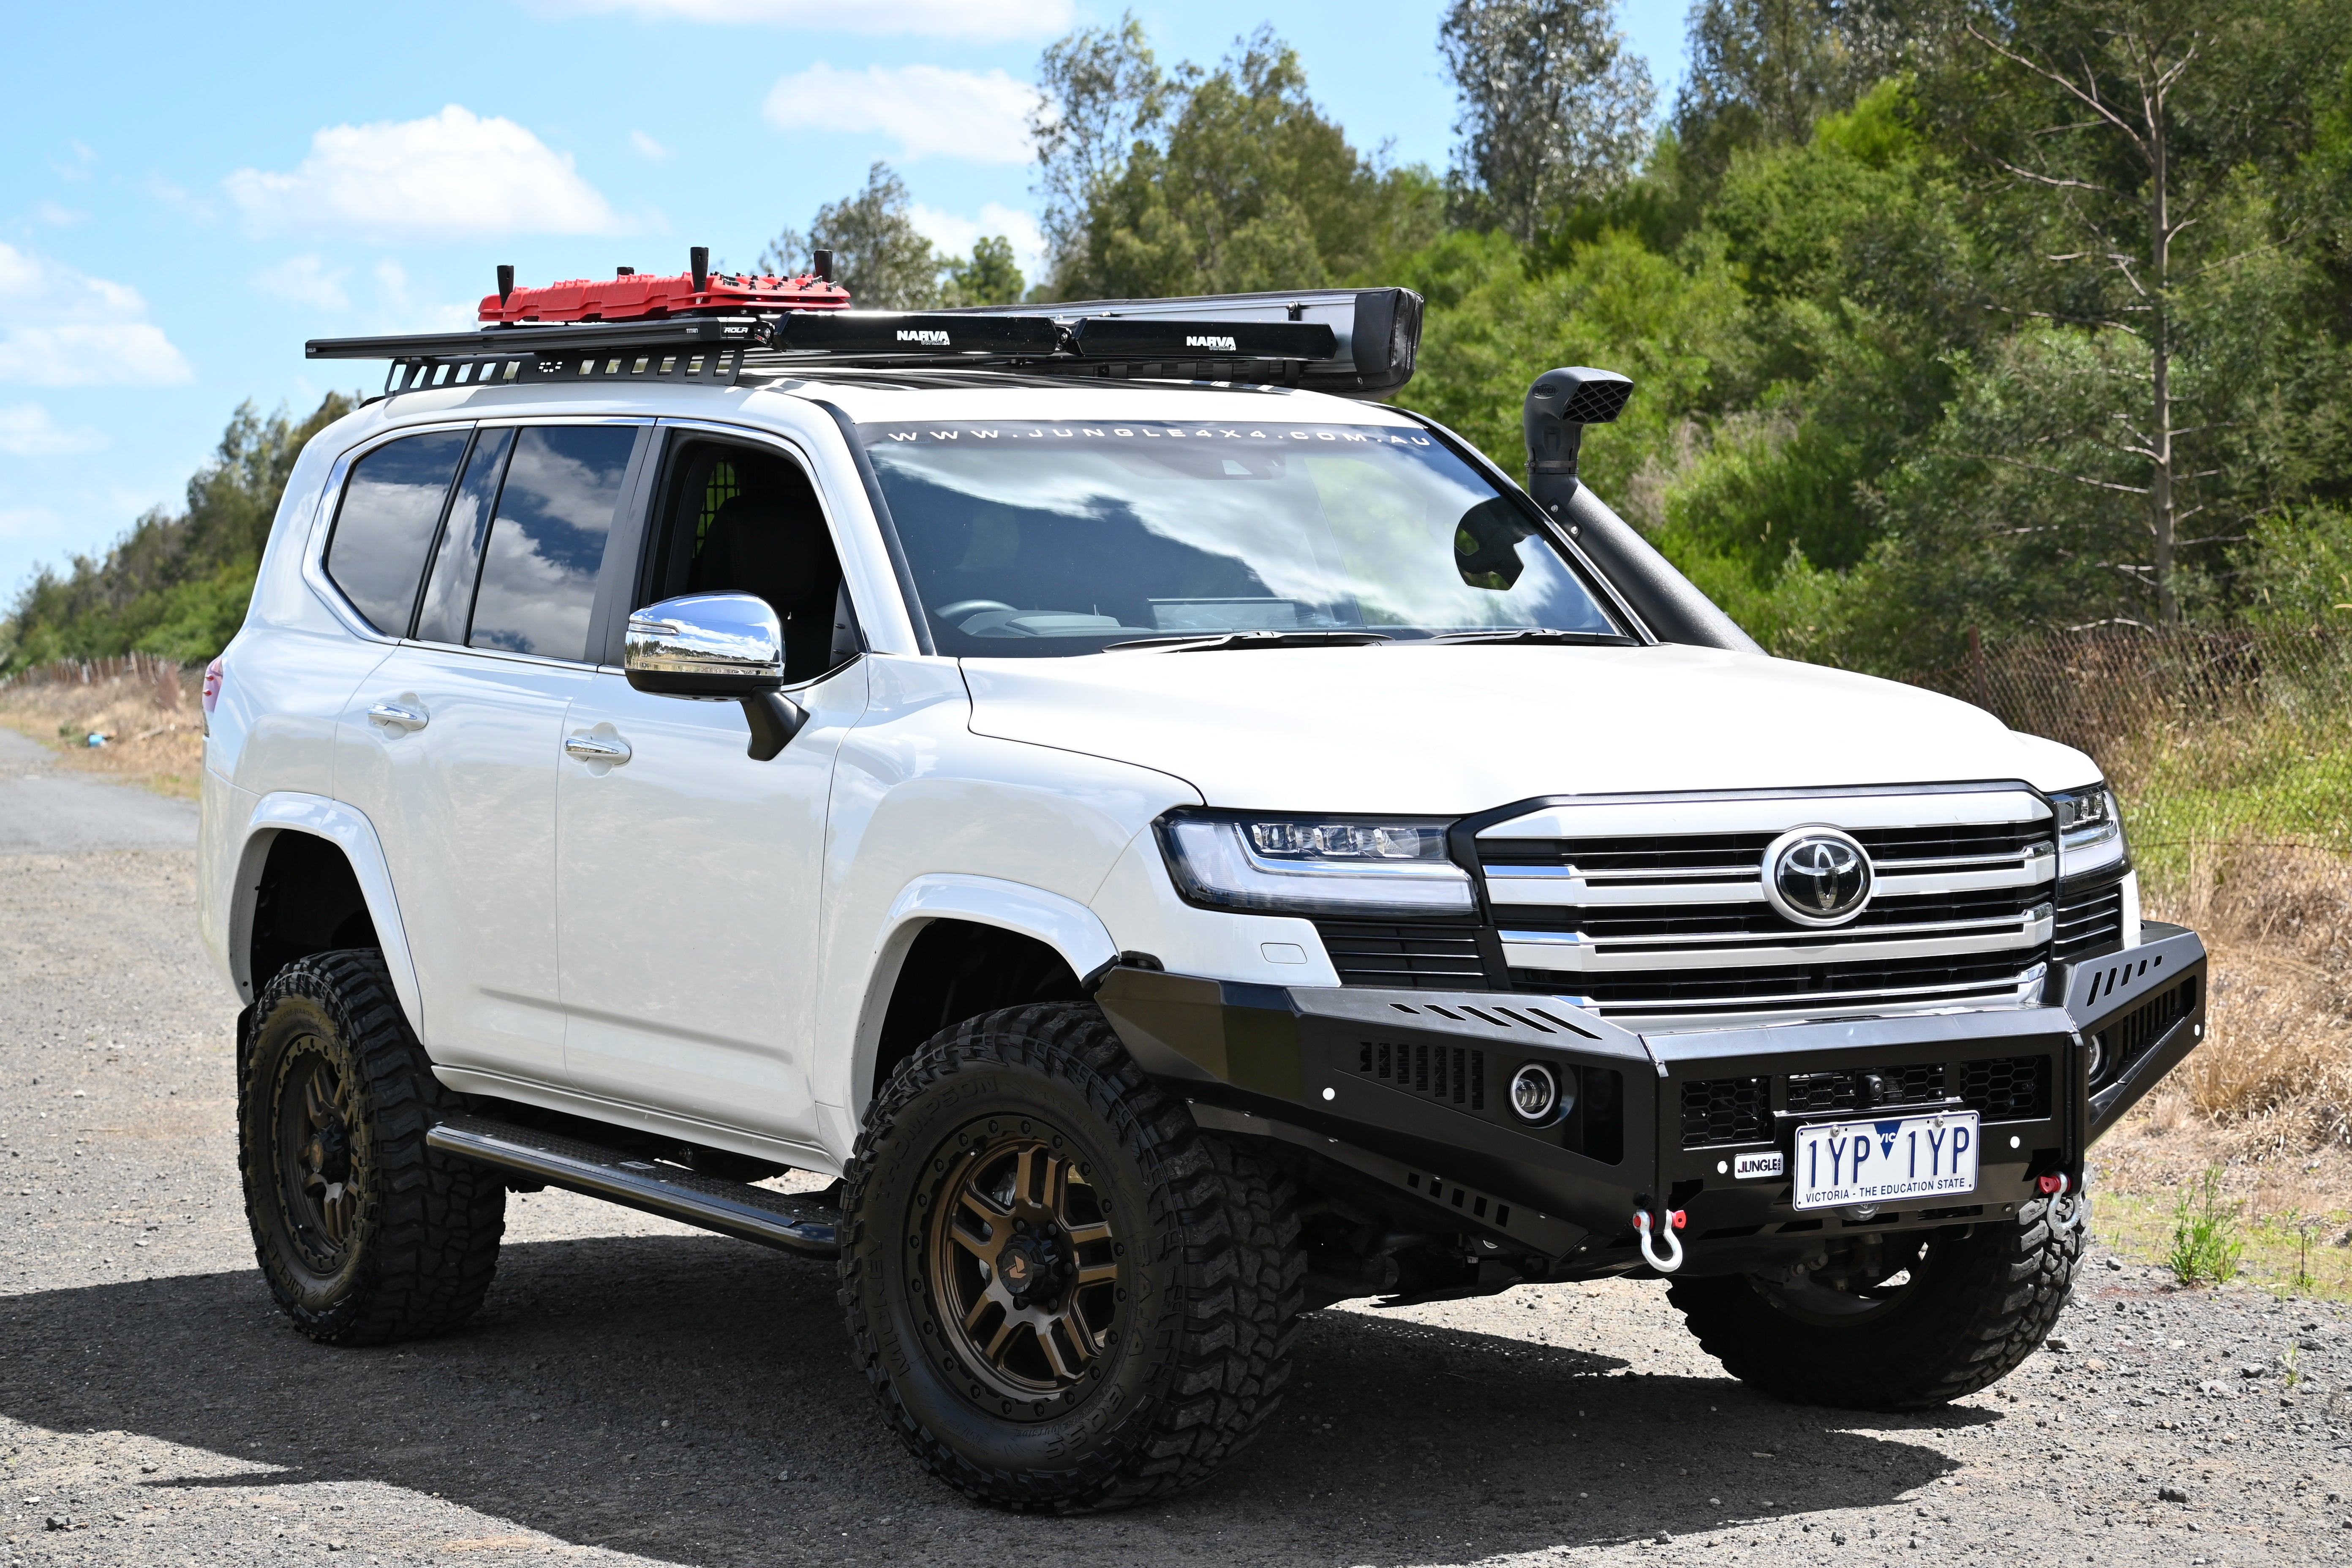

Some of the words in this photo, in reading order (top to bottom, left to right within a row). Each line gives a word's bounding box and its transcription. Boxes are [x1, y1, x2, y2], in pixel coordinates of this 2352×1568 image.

[897, 330, 950, 340] NARVA
[1187, 336, 1236, 346] NARVA
[1878, 1132, 1897, 1143] VIC
[1809, 1135, 1870, 1188] 1YP
[1908, 1127, 1969, 1178] 1YP
[1737, 1158, 1777, 1173] JUNGLE
[1806, 1190, 1849, 1203] VICTORIA
[1859, 1187, 1877, 1196] THE
[1881, 1181, 1934, 1195] EDUCATION
[1937, 1178, 1965, 1189] STATE
[1016, 1425, 1057, 1438] OUTSIDE
